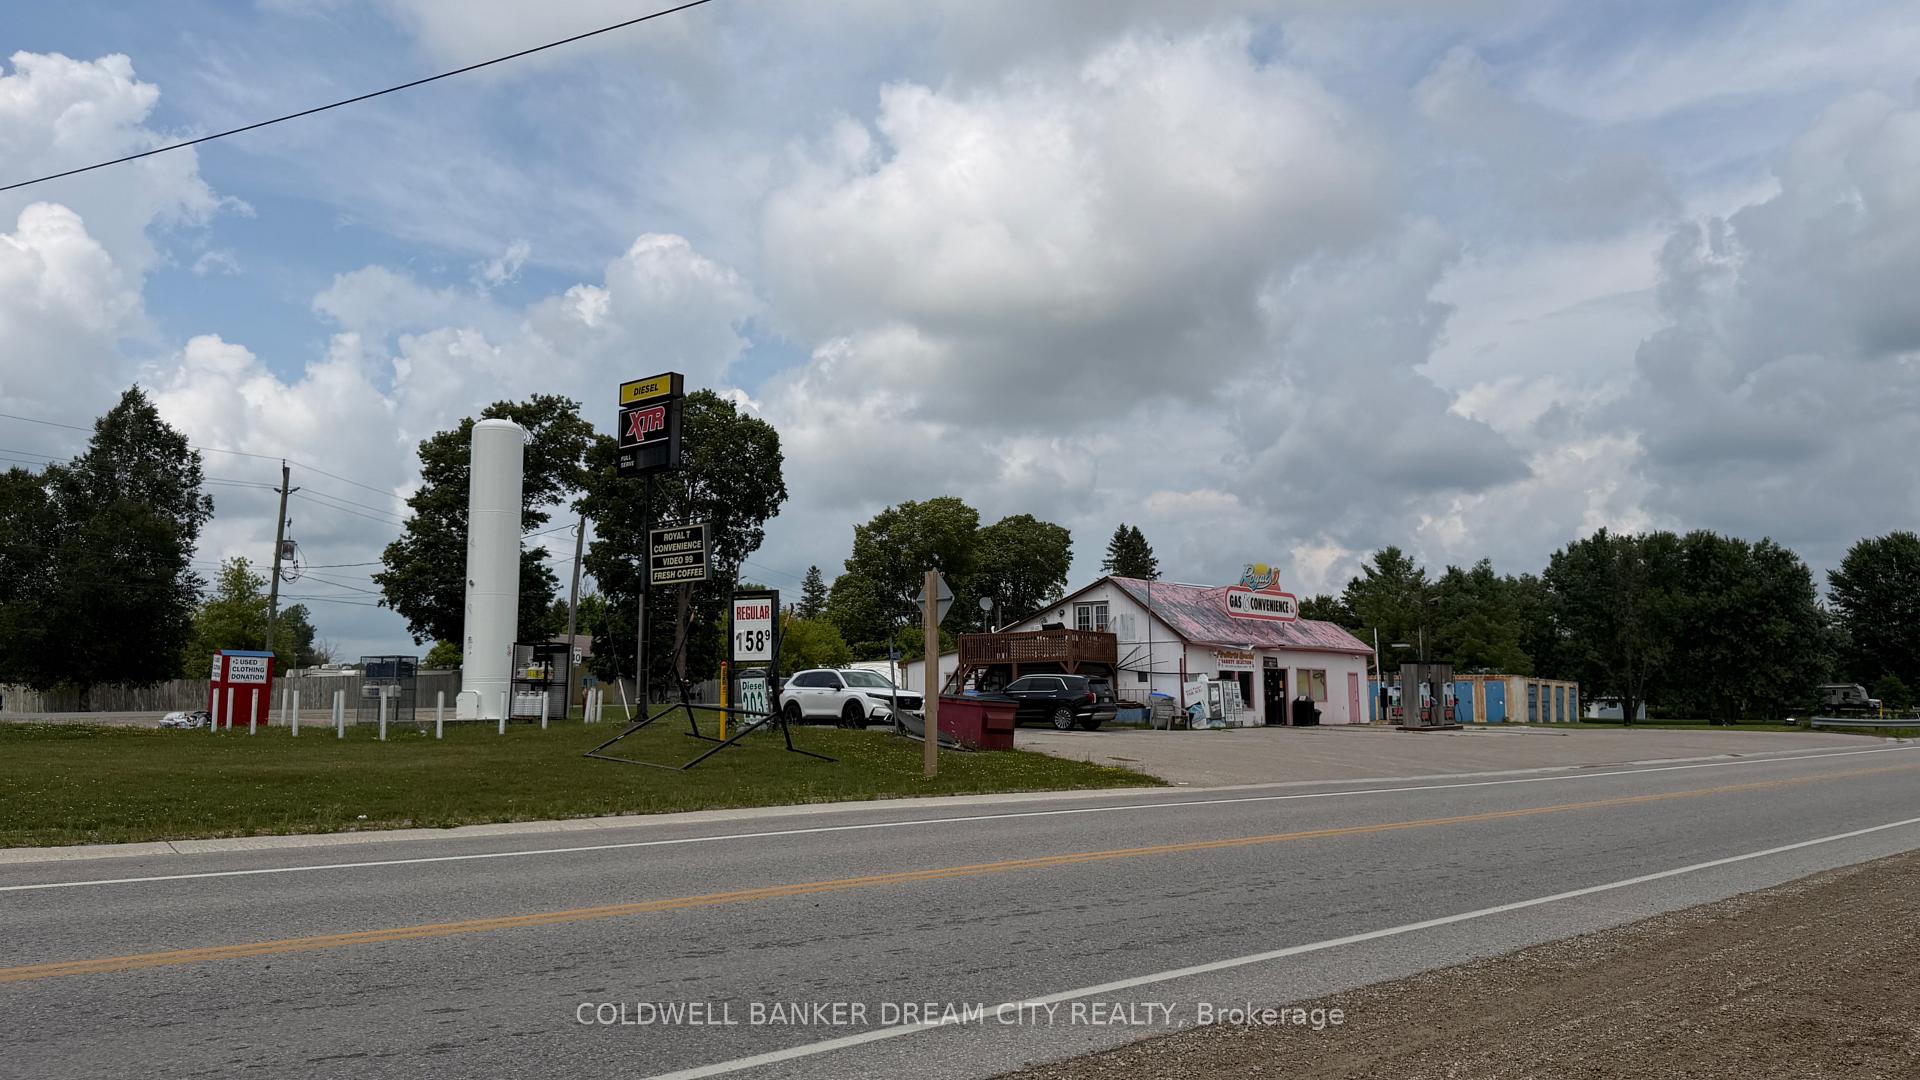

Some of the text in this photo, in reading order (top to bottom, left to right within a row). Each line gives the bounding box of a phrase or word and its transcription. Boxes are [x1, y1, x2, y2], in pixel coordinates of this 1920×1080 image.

[633, 383, 659, 396] DIESEL
[626, 406, 665, 442] XTR
[663, 530, 691, 541] ROYAL T
[653, 540, 702, 553] CONVENIENCE
[662, 556, 684, 566] VIDEO
[653, 567, 703, 580] FRESH COFFEE
[1229, 594, 1242, 609] GAS
[1250, 597, 1289, 614] CONVENIENCE
[736, 605, 770, 620] REGULAR
[742, 681, 765, 690] Diesel
